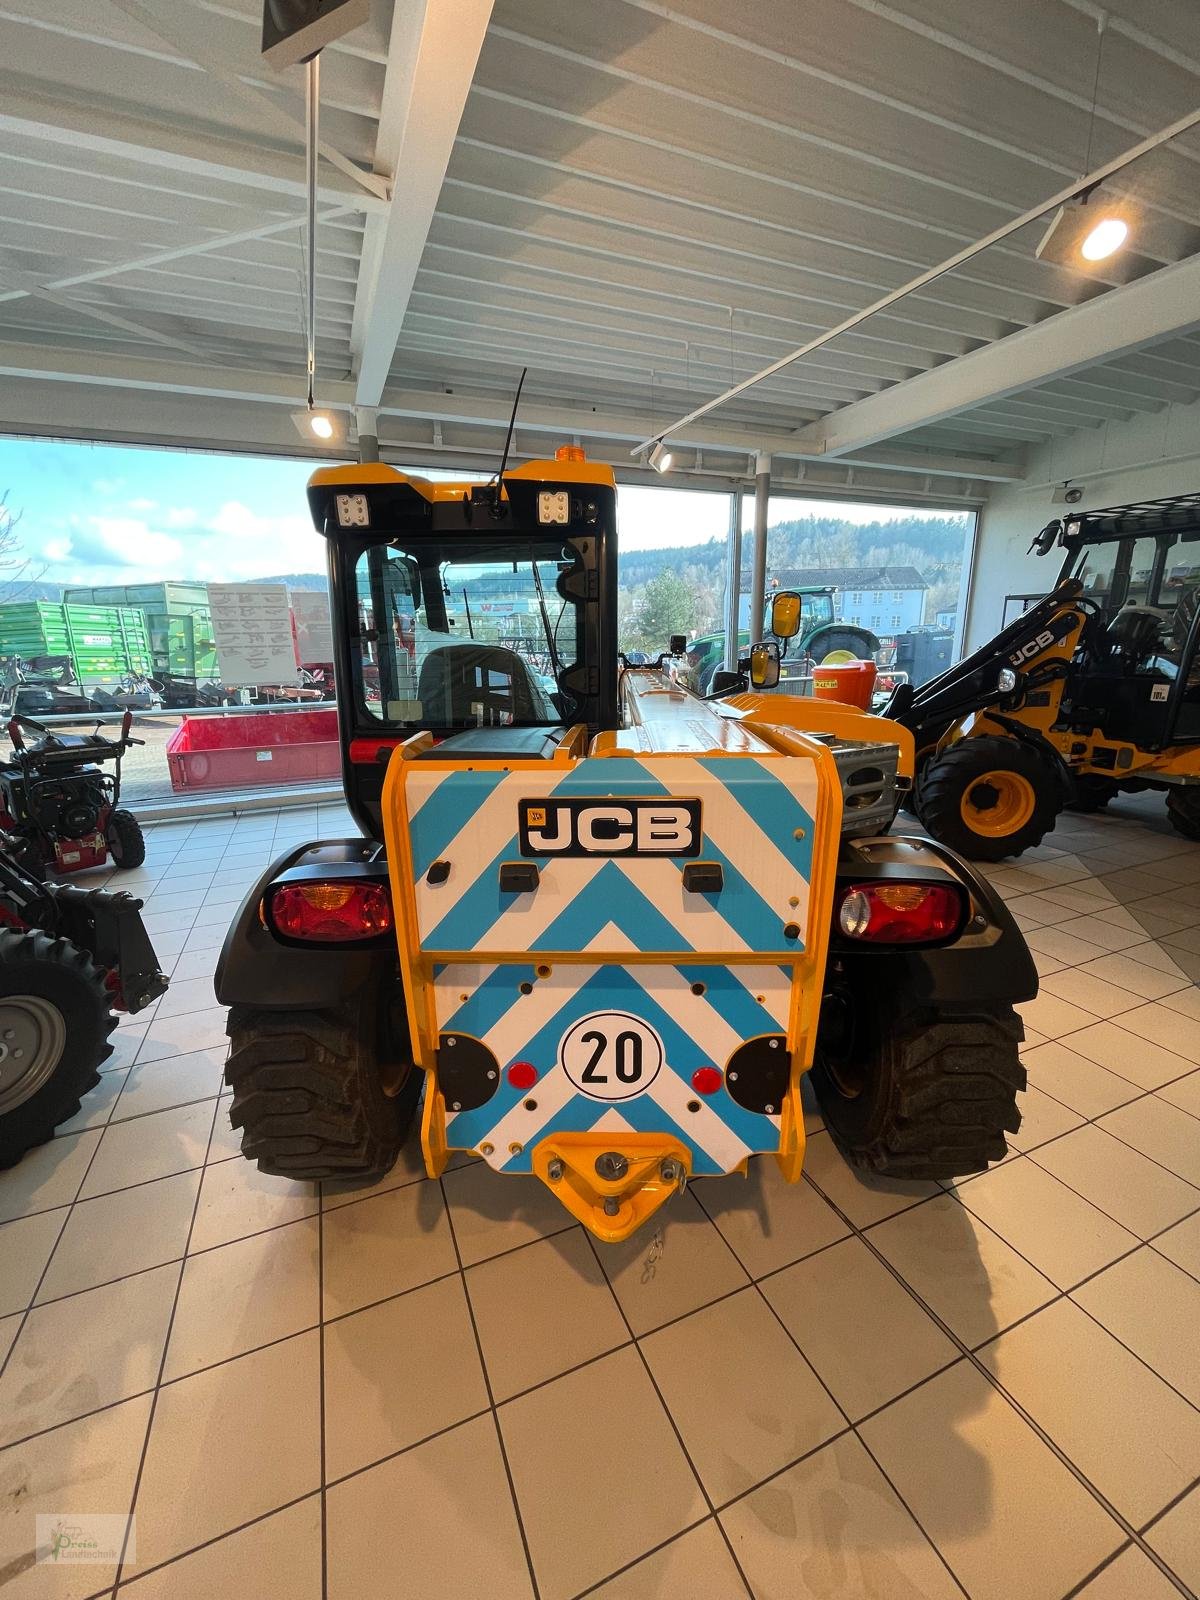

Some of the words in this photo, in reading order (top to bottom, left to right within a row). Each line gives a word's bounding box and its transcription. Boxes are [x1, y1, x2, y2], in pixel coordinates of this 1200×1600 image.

[1010, 630, 1055, 666] JCB
[527, 807, 692, 850] JCB
[581, 1031, 642, 1083] 20
